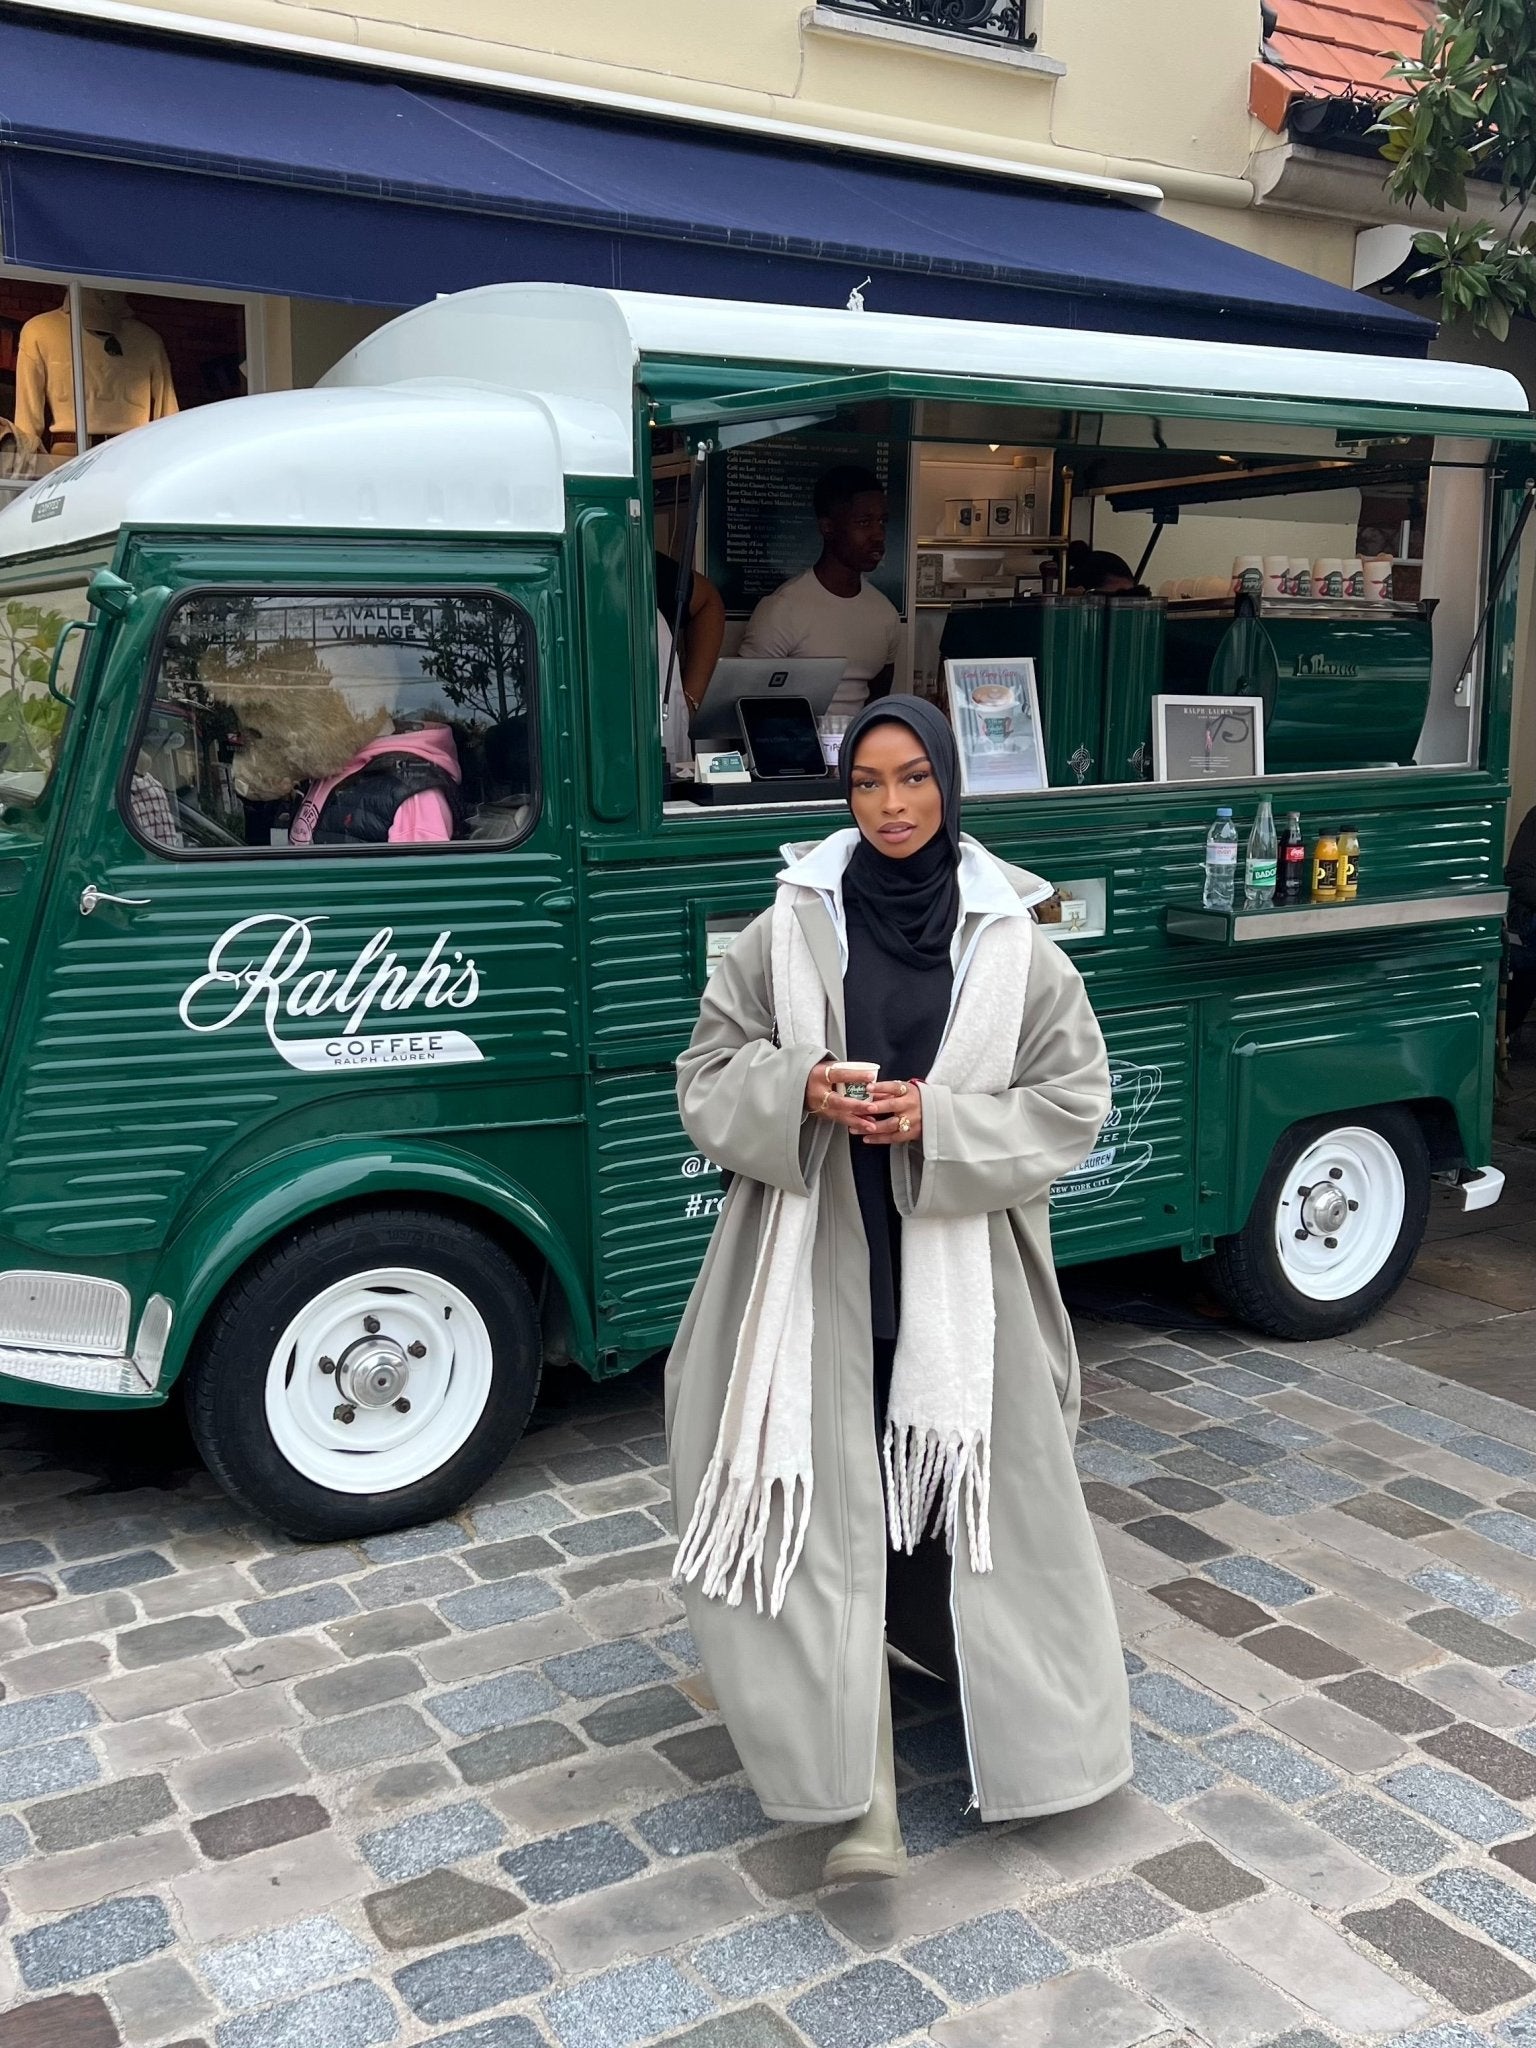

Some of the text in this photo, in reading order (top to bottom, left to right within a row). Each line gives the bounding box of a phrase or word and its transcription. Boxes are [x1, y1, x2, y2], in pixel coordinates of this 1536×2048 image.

[322, 607, 347, 620] LA
[332, 626, 416, 640] VILLAGE
[179, 913, 480, 1035] Ralph's
[325, 1036, 443, 1056] COFFEE
[334, 1052, 436, 1066] RALPH LAUREN
[1050, 1177, 1111, 1194] NEW YORK CITY
